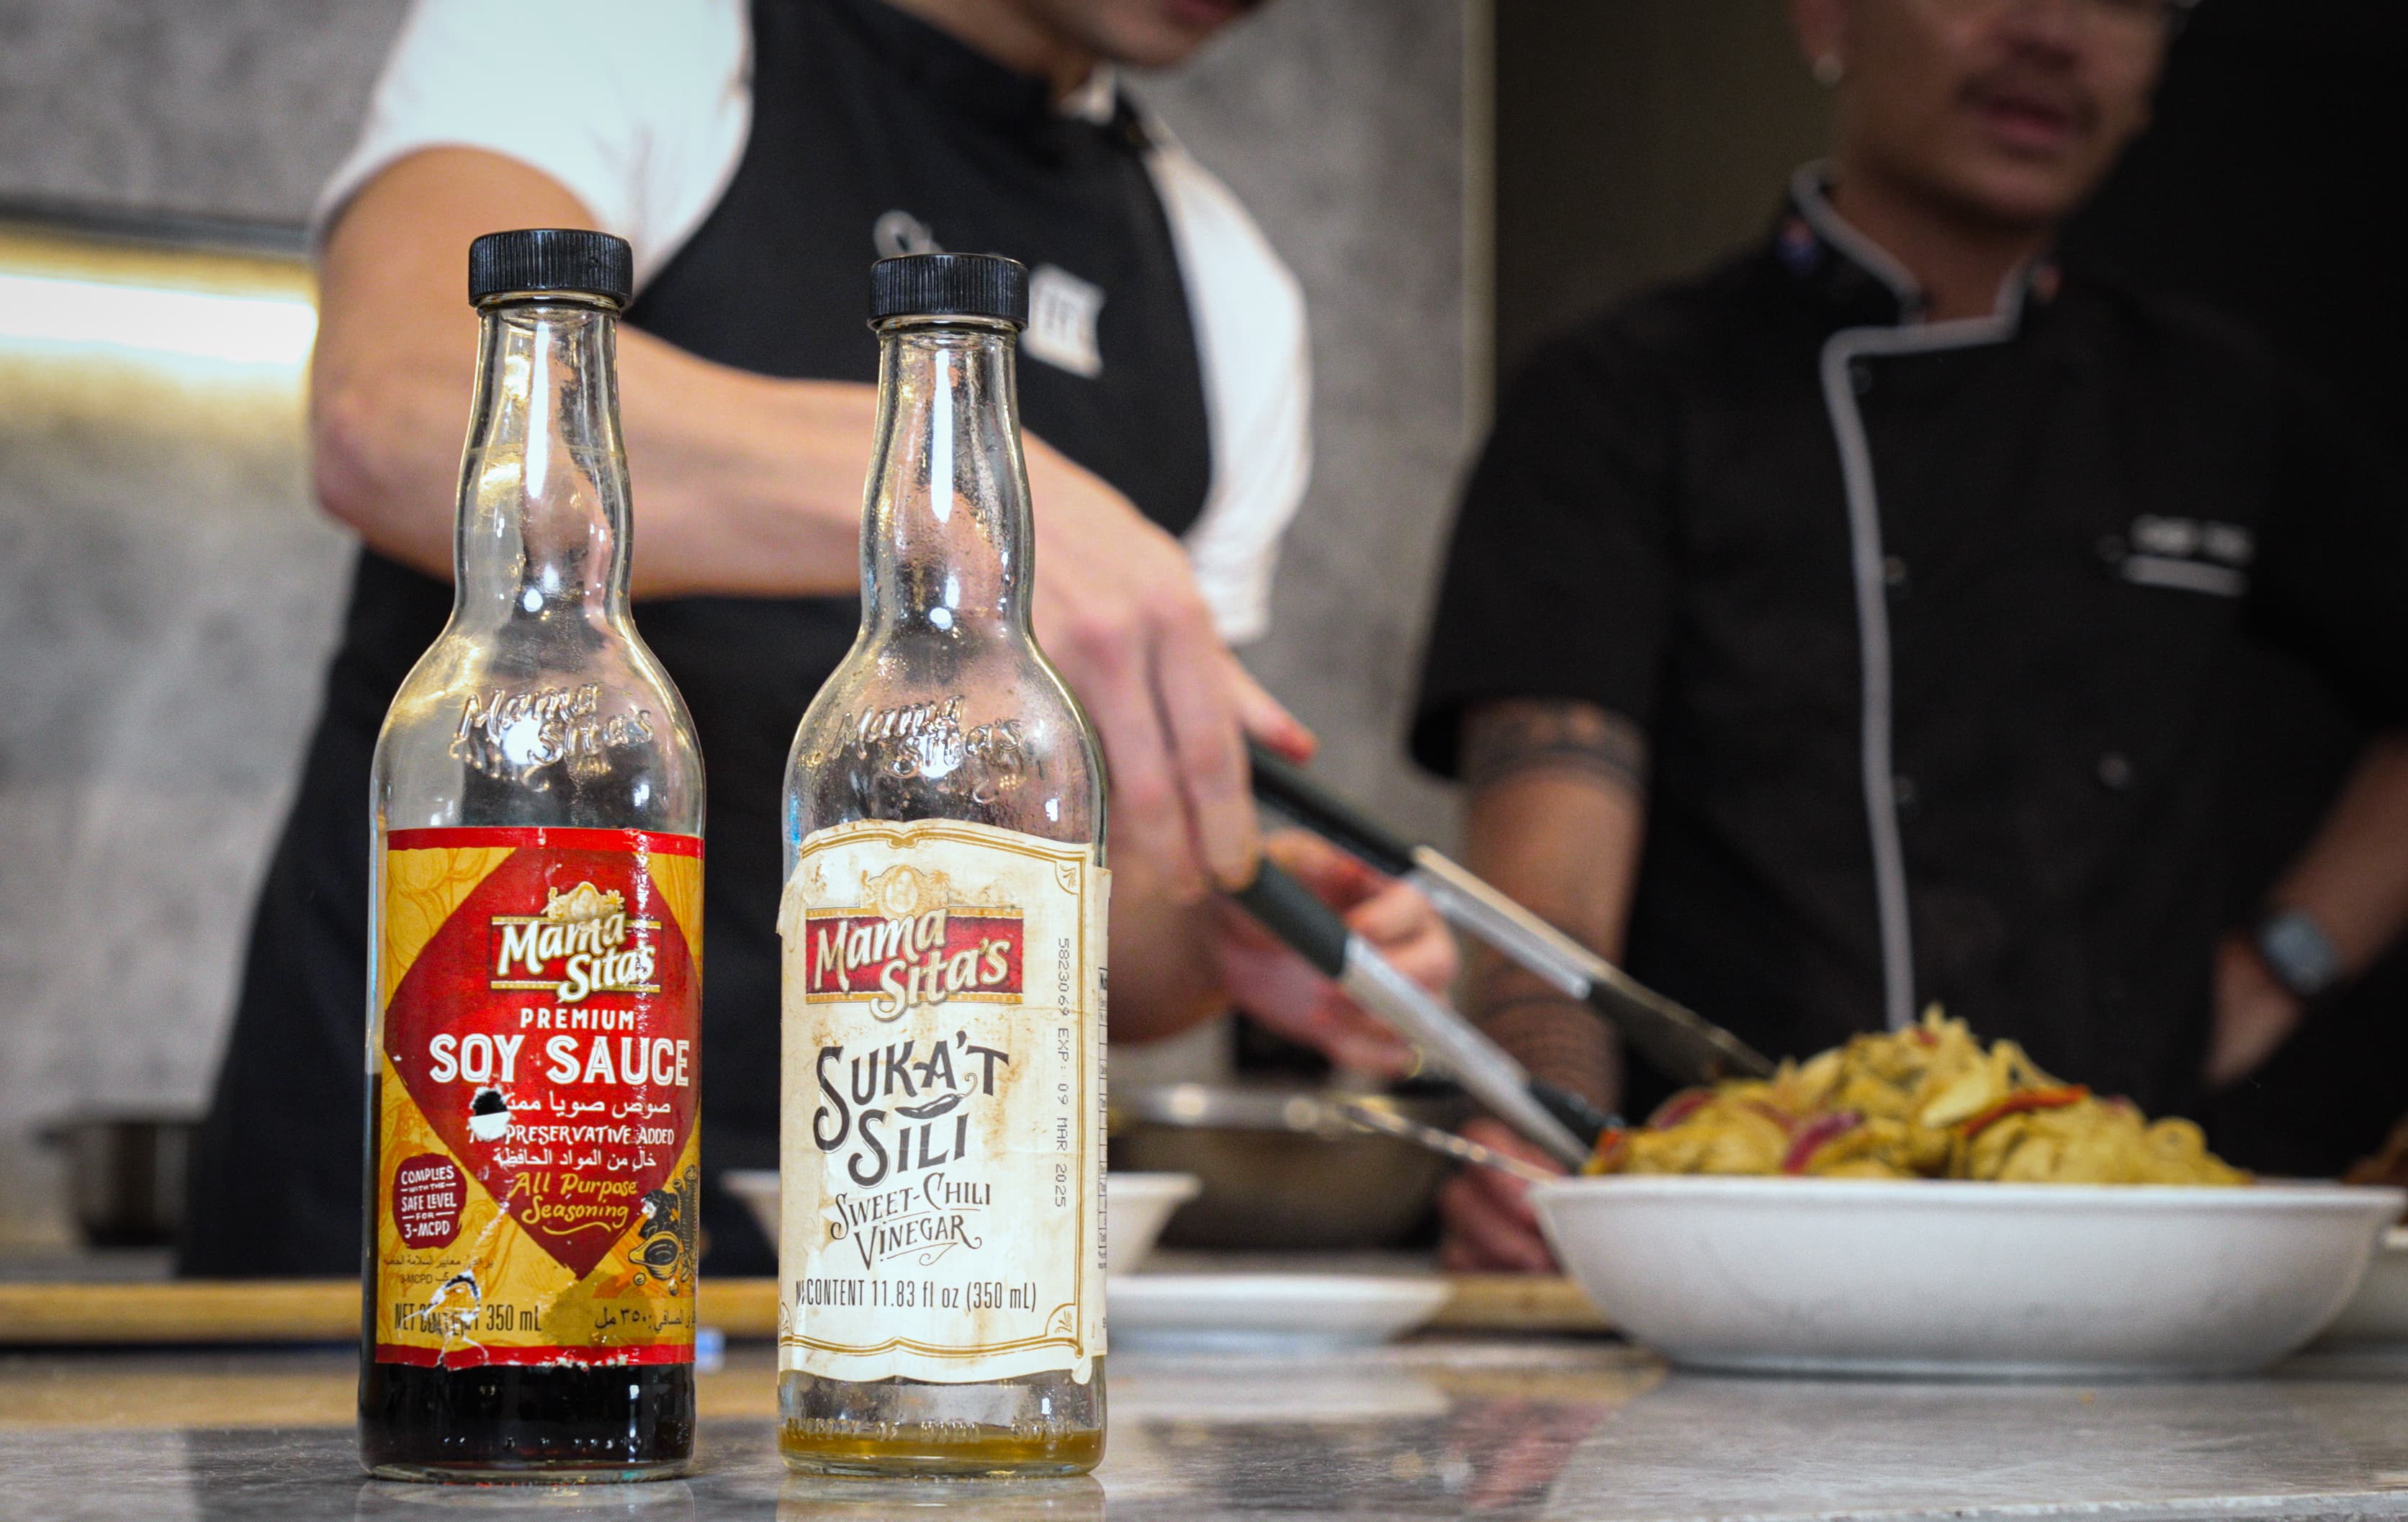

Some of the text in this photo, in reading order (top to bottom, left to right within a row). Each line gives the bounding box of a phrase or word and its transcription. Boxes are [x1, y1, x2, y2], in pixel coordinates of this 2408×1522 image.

[497, 913, 626, 976] Mama
[814, 908, 949, 992] Mama
[870, 938, 1012, 1019] Sita's
[1058, 937, 1070, 1017] 5823069
[520, 1009, 634, 1030] PREMIUM
[429, 1033, 689, 1086] SOY SAUCE
[549, 1091, 606, 1117] صويا
[813, 1030, 1010, 1153] SUKA'T
[1057, 1084, 1069, 1106] 09
[505, 1125, 632, 1145] PRESERVATIVE
[637, 1126, 674, 1145] ADDED
[848, 1109, 969, 1186] SILI
[1056, 1117, 1069, 1151] MAR
[493, 1148, 552, 1168] الحافظة
[560, 1150, 601, 1170] المواد
[607, 1153, 629, 1171] من
[401, 1166, 454, 1184] COMPLIES
[506, 1171, 638, 1202] All Purpose
[1055, 1163, 1067, 1208] 2025
[401, 1192, 457, 1212] SAFE LEVEL
[521, 1195, 629, 1228] Seasoning
[404, 1220, 450, 1238] 3-MCPD
[854, 1215, 982, 1270] VINEGAR
[807, 1279, 865, 1306] CONTENT
[872, 1280, 915, 1307] 11.83
[922, 1281, 933, 1307] fl
[942, 1287, 959, 1308] oz
[966, 1282, 1002, 1312] (350
[1010, 1282, 1037, 1312] mL)
[395, 1304, 415, 1330] NET
[487, 1304, 513, 1331] 350
[520, 1305, 542, 1331] mL
